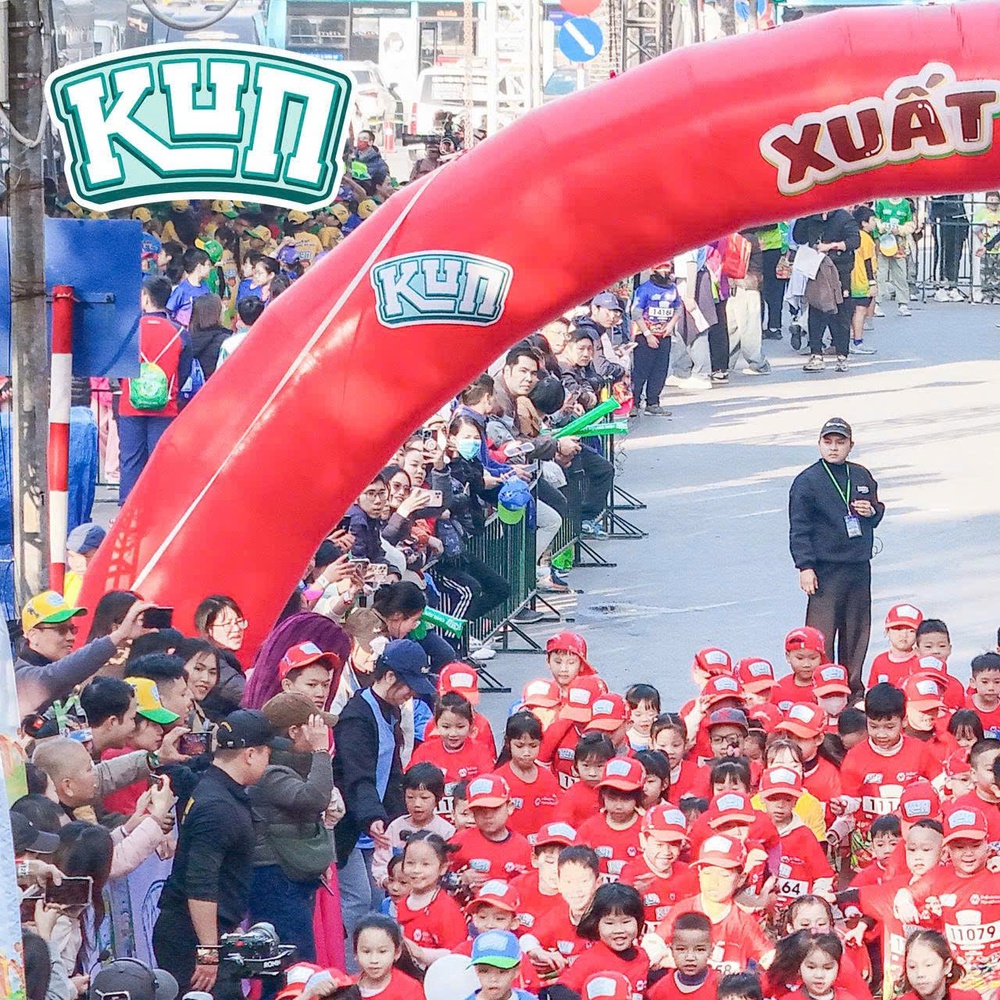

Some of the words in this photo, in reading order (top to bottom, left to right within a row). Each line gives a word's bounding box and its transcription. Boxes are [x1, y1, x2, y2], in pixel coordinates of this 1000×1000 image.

[769, 71, 999, 184] XUẤT
[782, 880, 801, 895] 64
[951, 924, 996, 942] 11079
